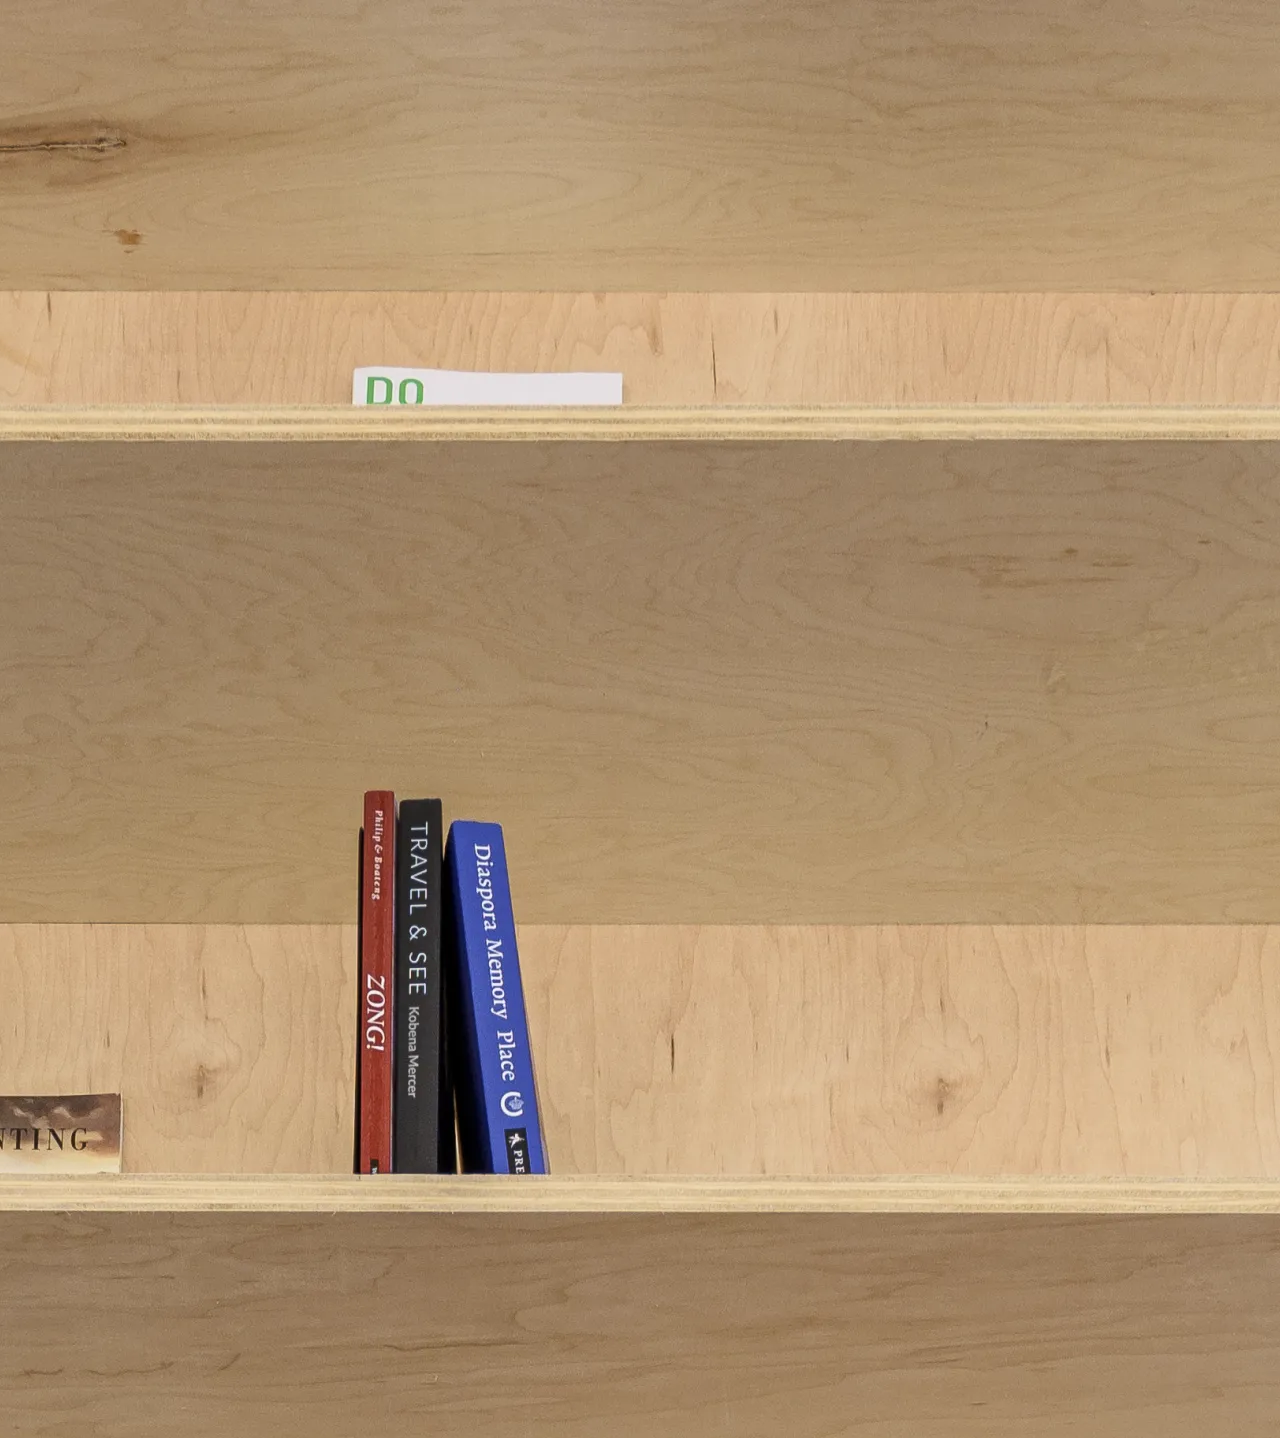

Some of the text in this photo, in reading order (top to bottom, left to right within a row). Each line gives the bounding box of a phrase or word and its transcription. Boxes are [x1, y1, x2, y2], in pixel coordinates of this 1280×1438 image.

[374, 810, 383, 844] Philip
[374, 845, 382, 854] &
[408, 821, 428, 995] TRAVEL & SEE
[474, 844, 515, 1081] Diaspora Memory Place
[366, 974, 386, 1051] ZONG!
[408, 1006, 420, 1098] Kobena Mercer
